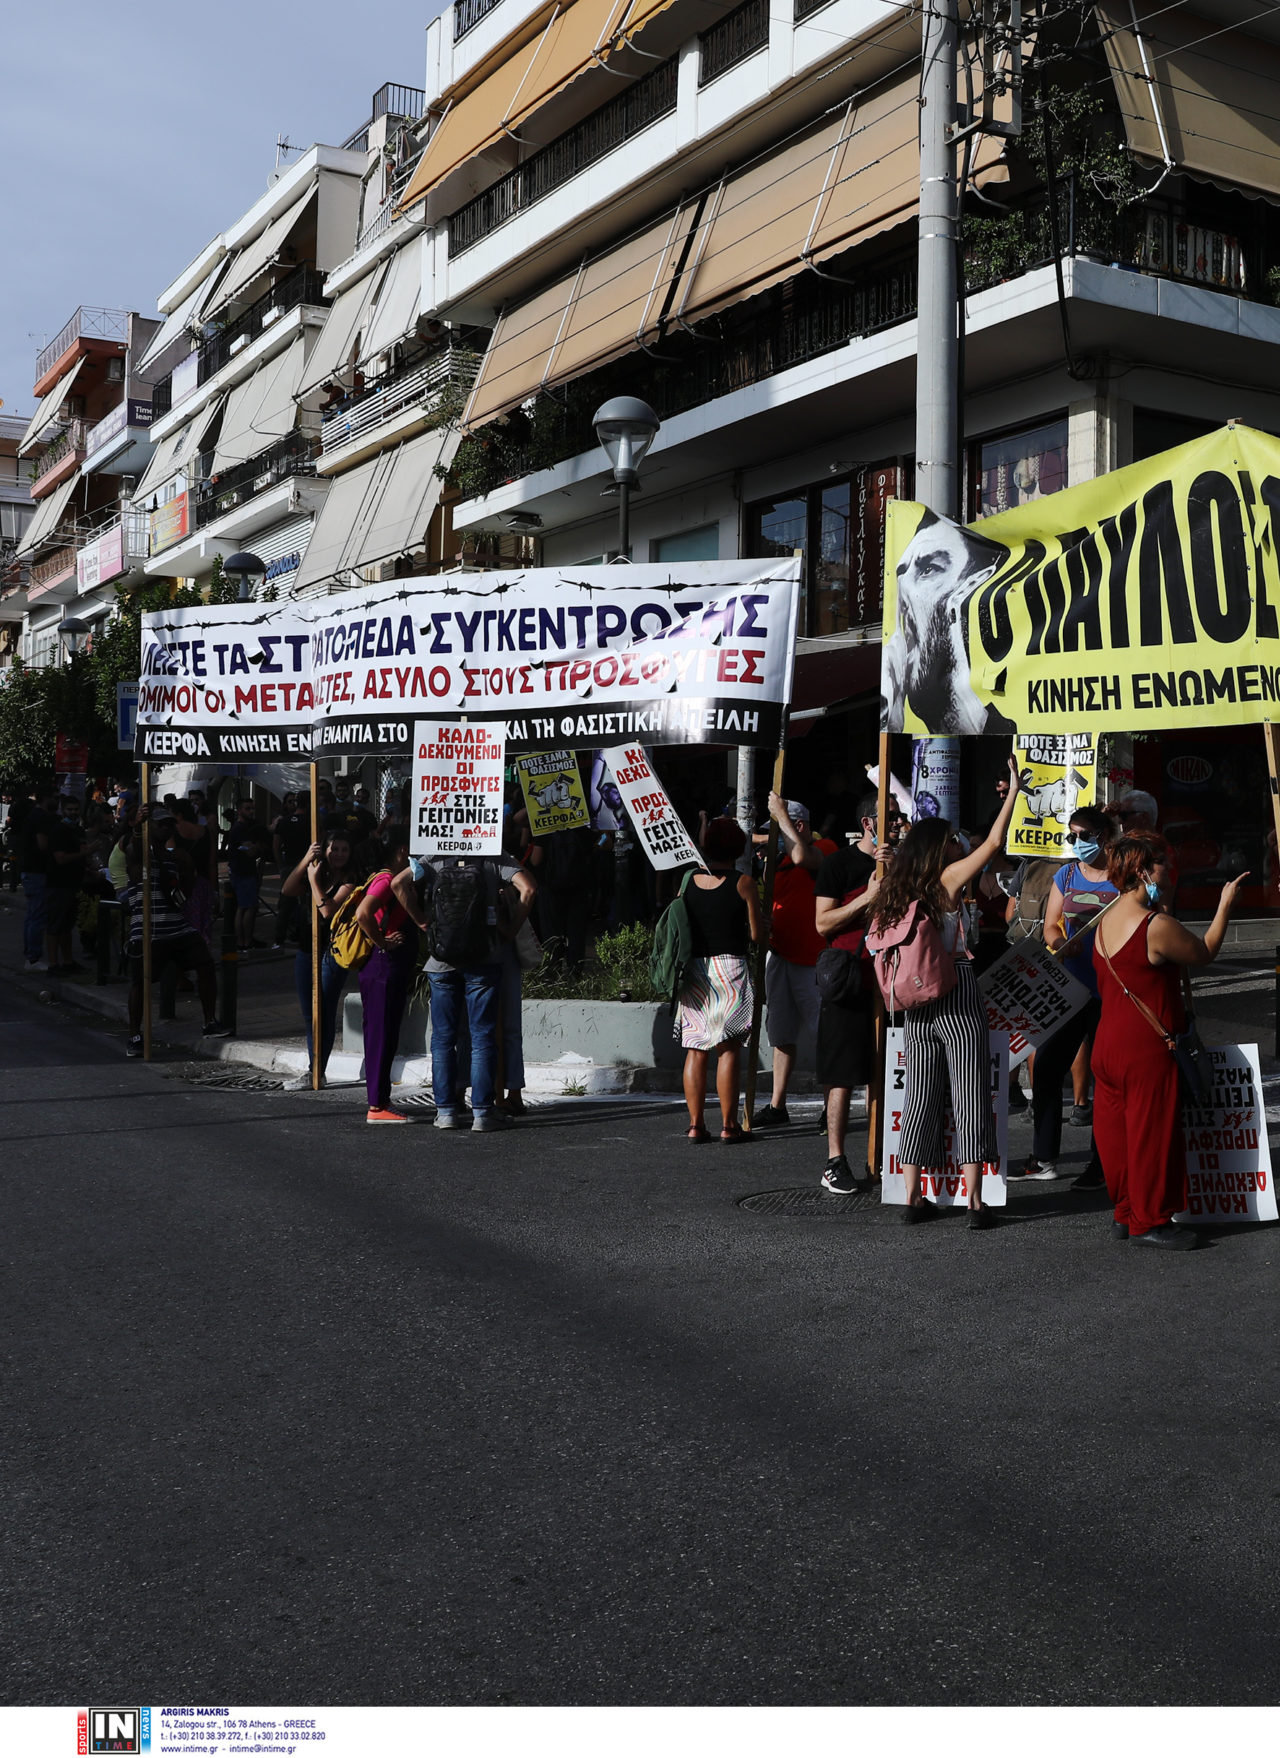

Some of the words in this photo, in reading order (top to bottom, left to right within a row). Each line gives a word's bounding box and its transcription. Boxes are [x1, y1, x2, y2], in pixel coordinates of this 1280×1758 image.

[213, 643, 250, 676] ΤΑ
[430, 594, 770, 654] ΣΥΓΚΕΝΤΡΩΣΗΣ
[205, 689, 227, 713] ΟΙ
[363, 665, 451, 699] ΑΣΥΛΟ
[464, 666, 534, 696] ΣΤΟΥΣ
[545, 649, 766, 692] ΠΡΟΣΦΥΓΕΣ
[1028, 674, 1122, 714] ΚΙΝΗΣΗ
[144, 731, 211, 756] ΚΕΕΡΦΑ
[219, 734, 281, 752] ΚΙΝΗΣΗ
[321, 722, 370, 746] ΕΝΑΝΤΙΑ
[378, 723, 408, 743] ΣΤΟ
[505, 720, 528, 740] ΚΑΙ
[531, 718, 555, 739] ΤΗ
[560, 709, 662, 737] ΦΑΣΙΣΤΙΚΗ
[669, 708, 759, 733] ΑΠΕΙΛΗ
[438, 728, 492, 743] ΚΑΛΟ-
[1020, 735, 1053, 750] ΠΟΤΕ
[1056, 733, 1088, 750] ΞΑΝΑ
[418, 744, 501, 760] ΔΕΧΟΥΜΕΝΟΙ
[521, 756, 544, 770] ΠΟΤΕ
[544, 751, 569, 764] ΞΑΝΑ
[1030, 748, 1094, 765] ΦΑΣΙΣΜΟΣ
[456, 762, 474, 774] ΟΙ
[529, 761, 575, 776] ΦΑΣΙΣΜΟΣ
[921, 764, 929, 779] 8
[421, 776, 500, 792] ΠΡΟΣΦΥΓΕΣ
[454, 795, 485, 807] ΣΤΙΣ
[419, 808, 498, 823] ΓΕΙΤΟΝΙΕΣ
[534, 813, 577, 829] ΚΕΕΡΦΑ
[418, 825, 454, 838] ΜΑΣ!
[437, 841, 473, 851] ΚΕΕΡΦΑ
[649, 835, 685, 856] ΜΑΣ!
[1038, 954, 1070, 988] ΚΕΕΡΦΑ
[986, 983, 1018, 1013] ΣΤΙΣ
[990, 965, 1059, 1030] ΓΕΙΤΟΝΙΕΣ
[1035, 980, 1072, 1016] ΜΑΣ!
[1184, 1129, 1259, 1152] ΠΡΟΣΦΥ
[1199, 1153, 1220, 1170] ΟΙ
